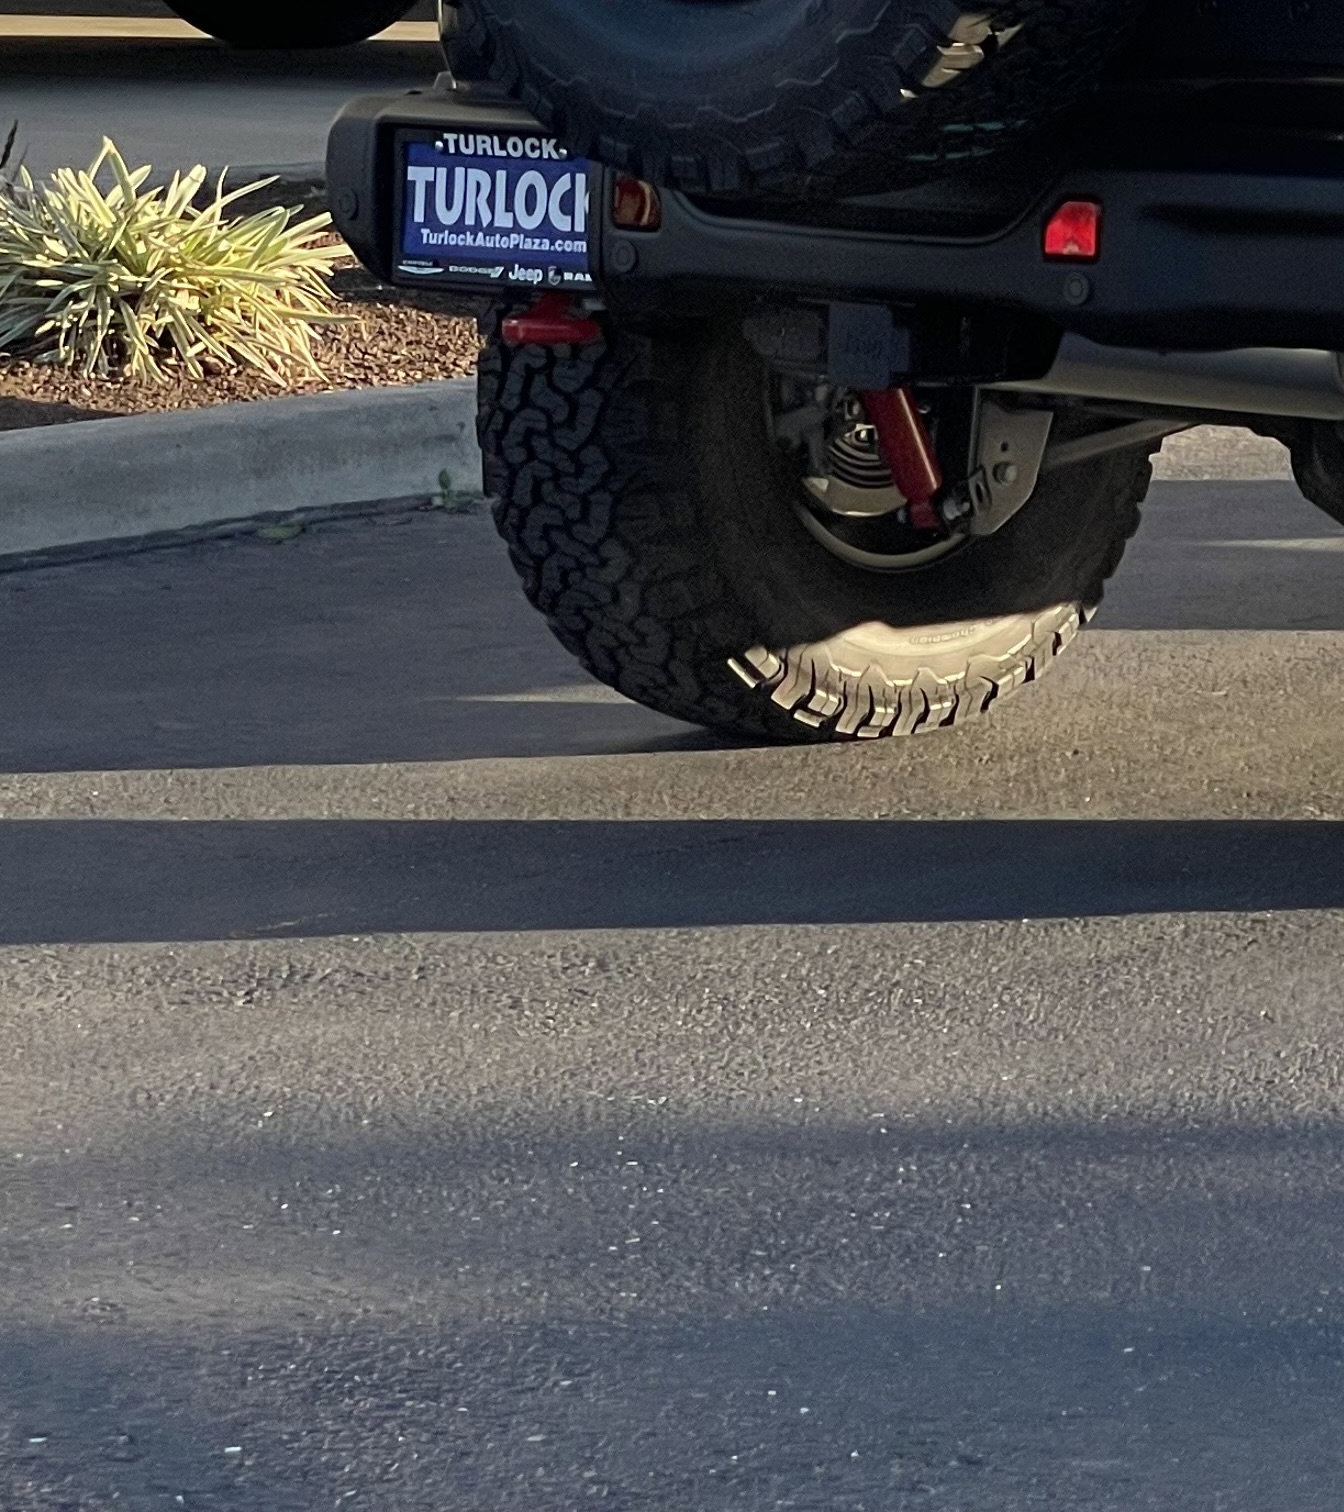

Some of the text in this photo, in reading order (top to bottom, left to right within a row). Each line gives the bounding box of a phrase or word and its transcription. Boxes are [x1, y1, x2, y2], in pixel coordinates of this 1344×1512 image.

[443, 132, 559, 160] TURLOCK
[420, 228, 588, 254] TurlockAutoPlaza.com
[509, 263, 544, 285] Jeep
